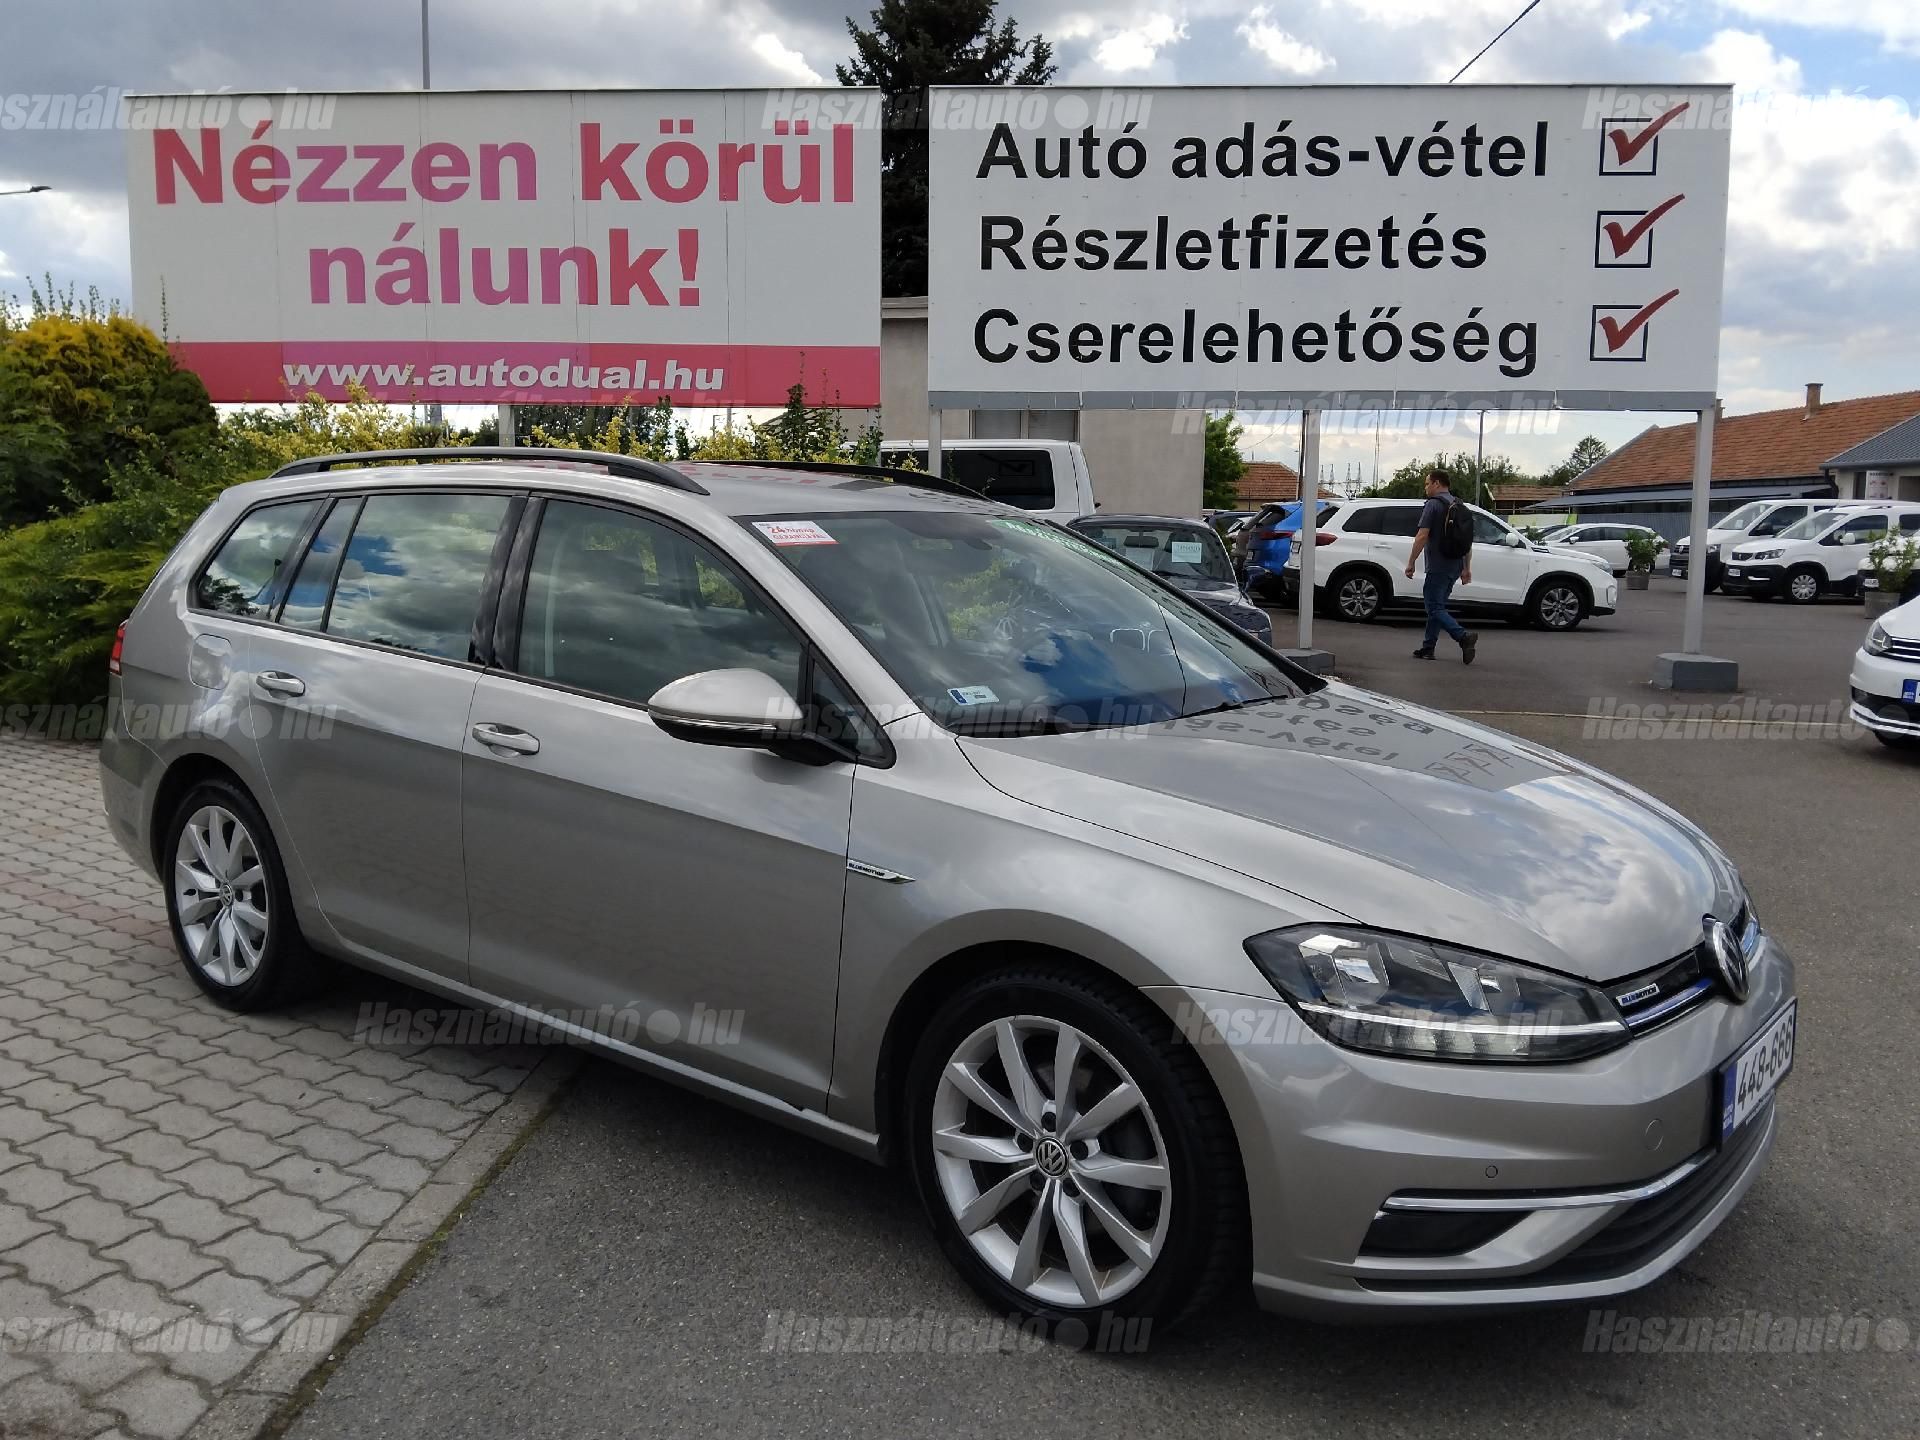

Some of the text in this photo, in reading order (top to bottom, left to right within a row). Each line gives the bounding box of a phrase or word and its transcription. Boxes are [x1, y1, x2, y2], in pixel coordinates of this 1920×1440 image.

[154, 119, 853, 205] Nézzen körül
[976, 119, 1549, 180] Autó adás-vétel
[310, 223, 701, 307] nálunk!
[980, 212, 1487, 271] Részletfizetés
[283, 357, 725, 392] www.autodual.hu
[974, 306, 1537, 378] Cserelehetőség
